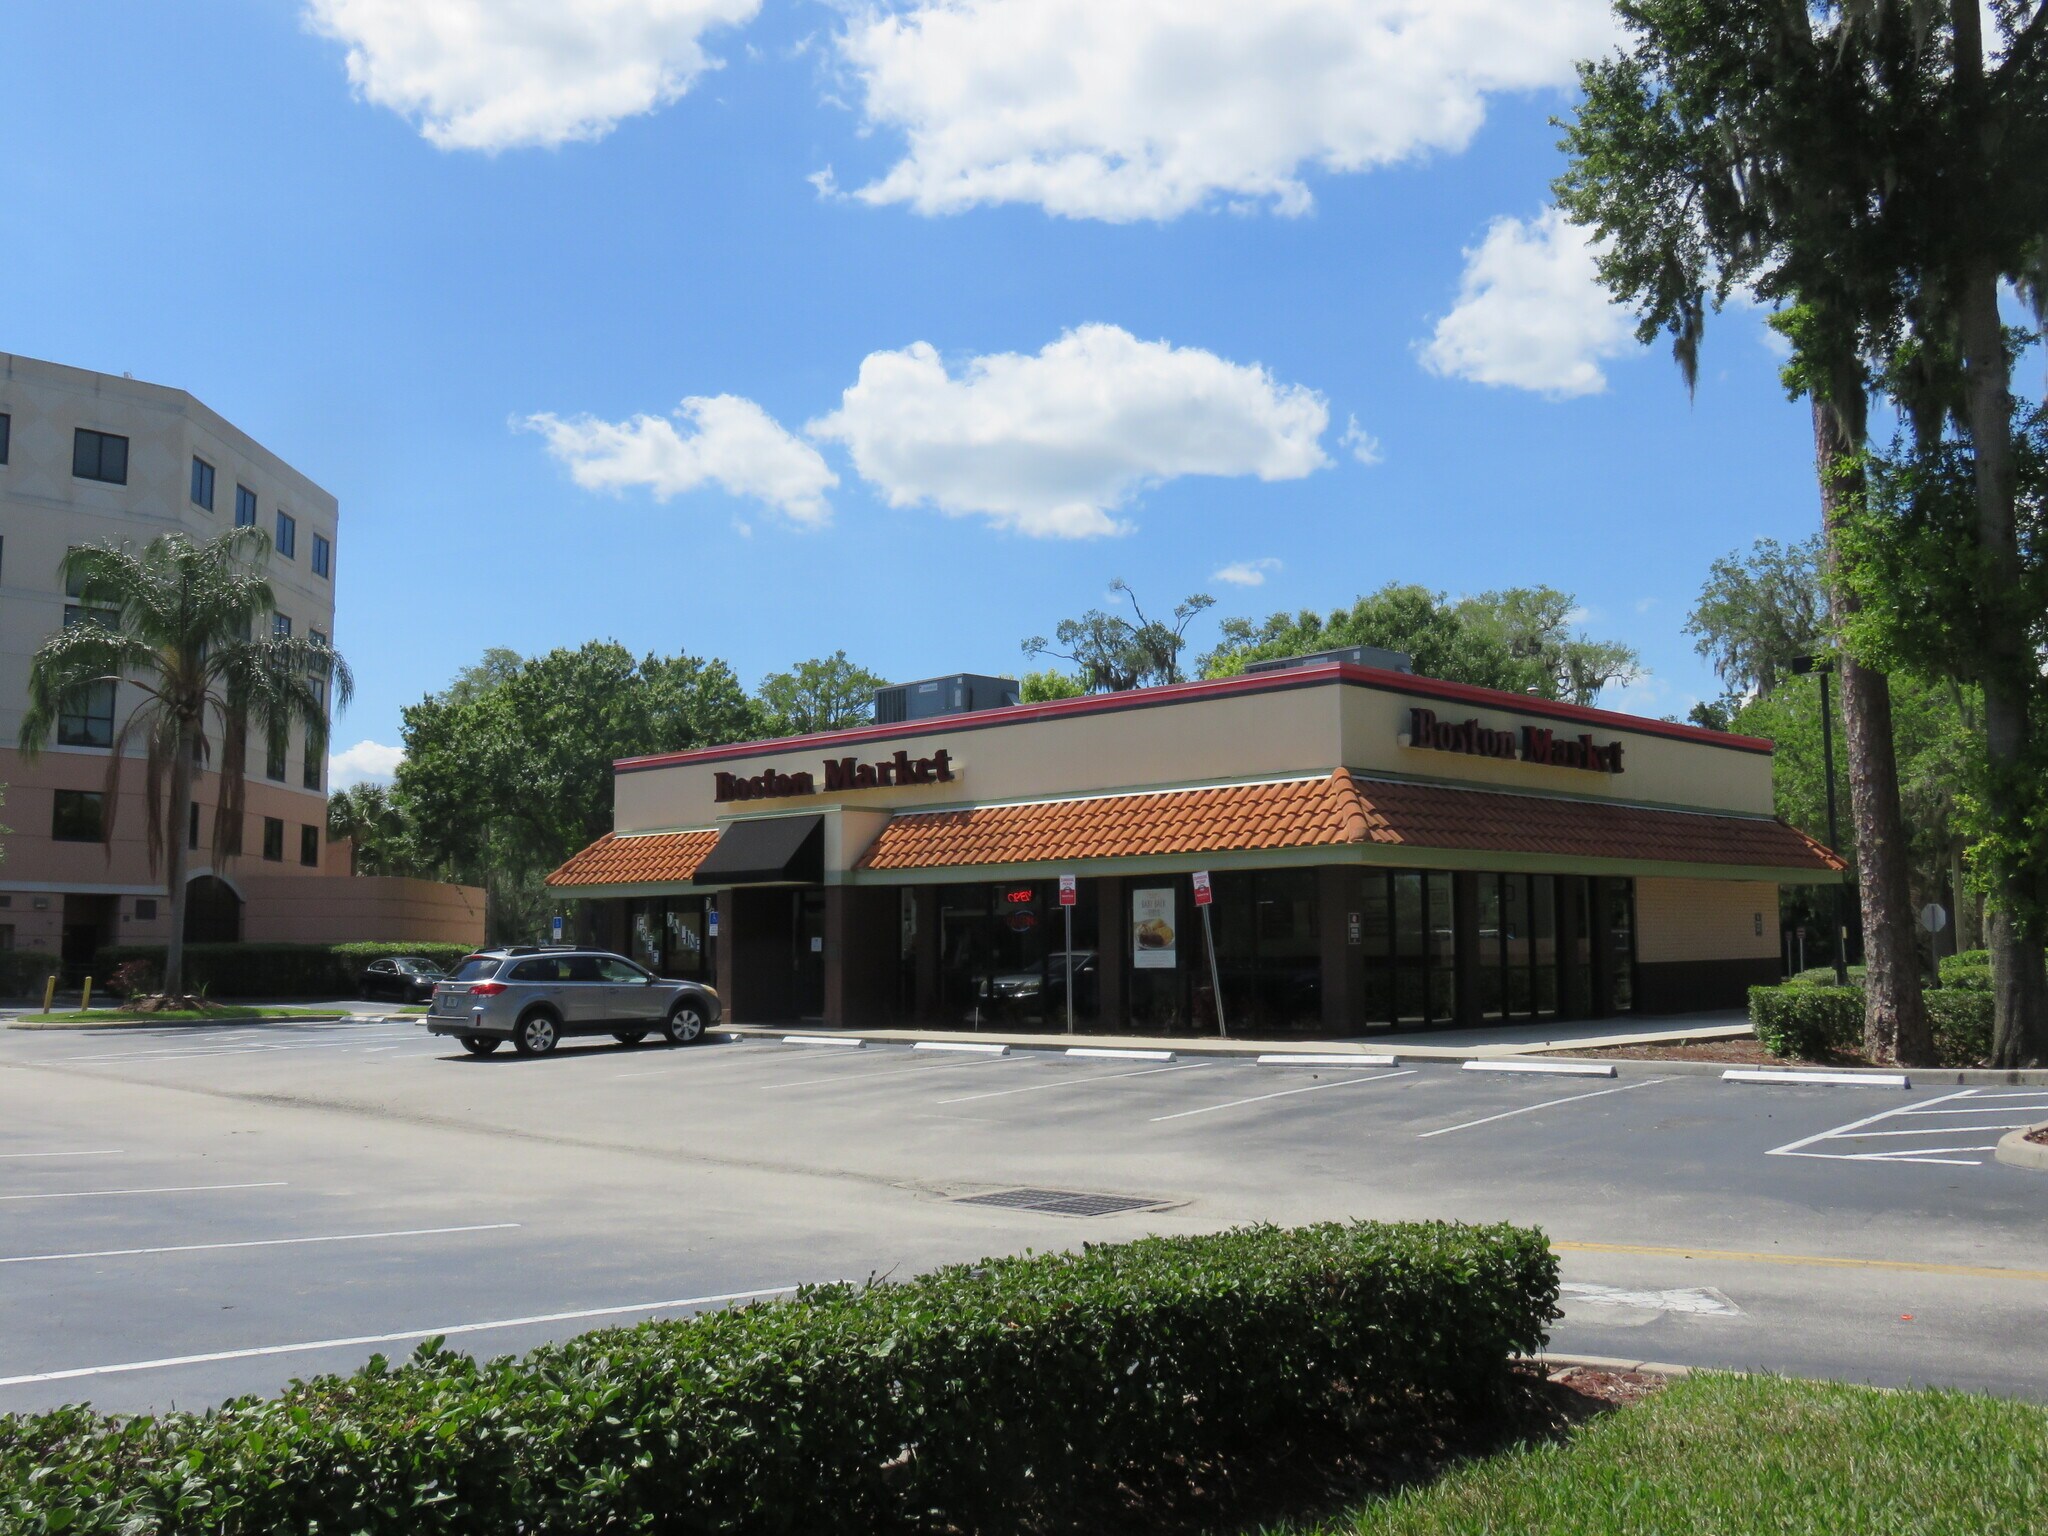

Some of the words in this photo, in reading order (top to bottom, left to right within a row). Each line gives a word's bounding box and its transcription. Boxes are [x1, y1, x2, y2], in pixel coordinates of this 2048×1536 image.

[1409, 708, 1517, 760] Boston
[1520, 726, 1624, 773] Market
[714, 769, 815, 802] Boston
[823, 749, 953, 791] Market
[1008, 890, 1032, 902] OPEN
